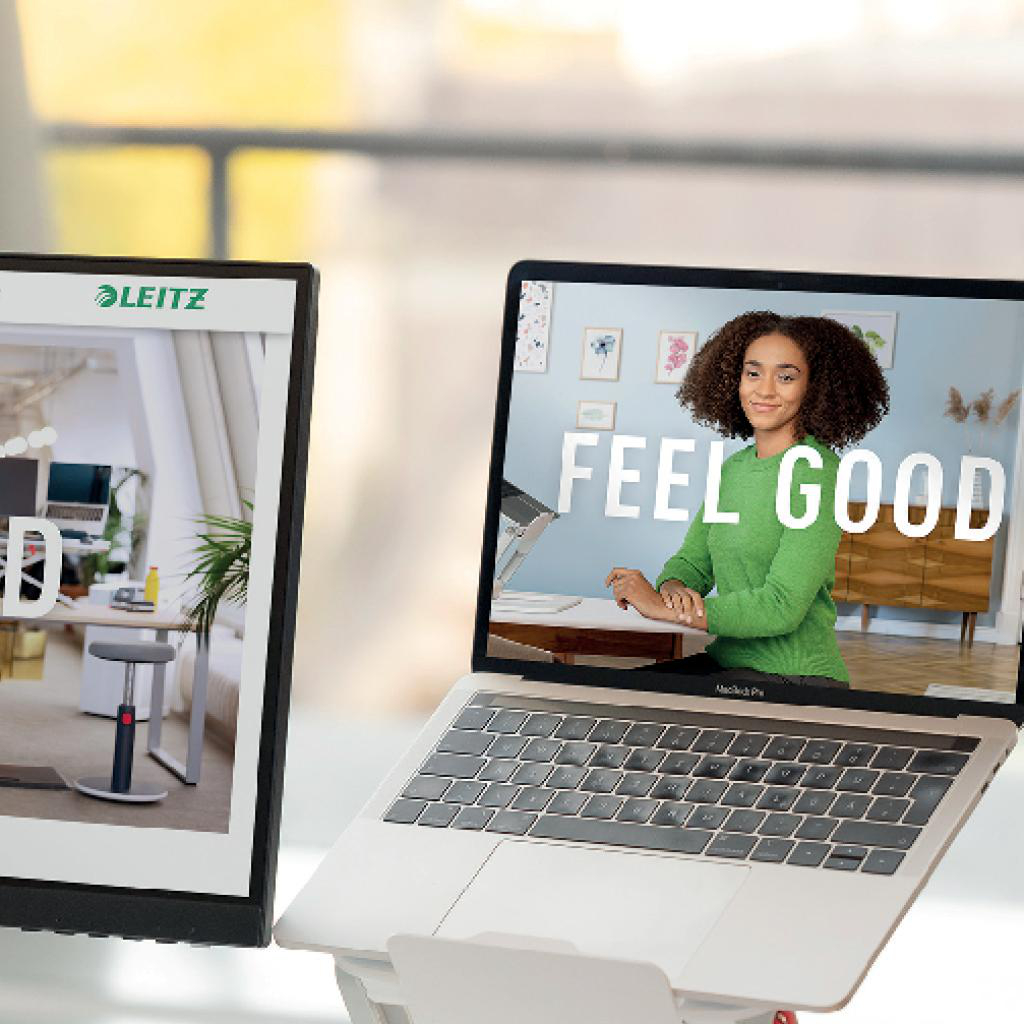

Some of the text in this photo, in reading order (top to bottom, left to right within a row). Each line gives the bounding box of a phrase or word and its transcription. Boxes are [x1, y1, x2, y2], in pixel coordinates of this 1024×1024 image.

[119, 286, 209, 310] LEITZ
[558, 431, 1006, 542] FEEL GOOD
